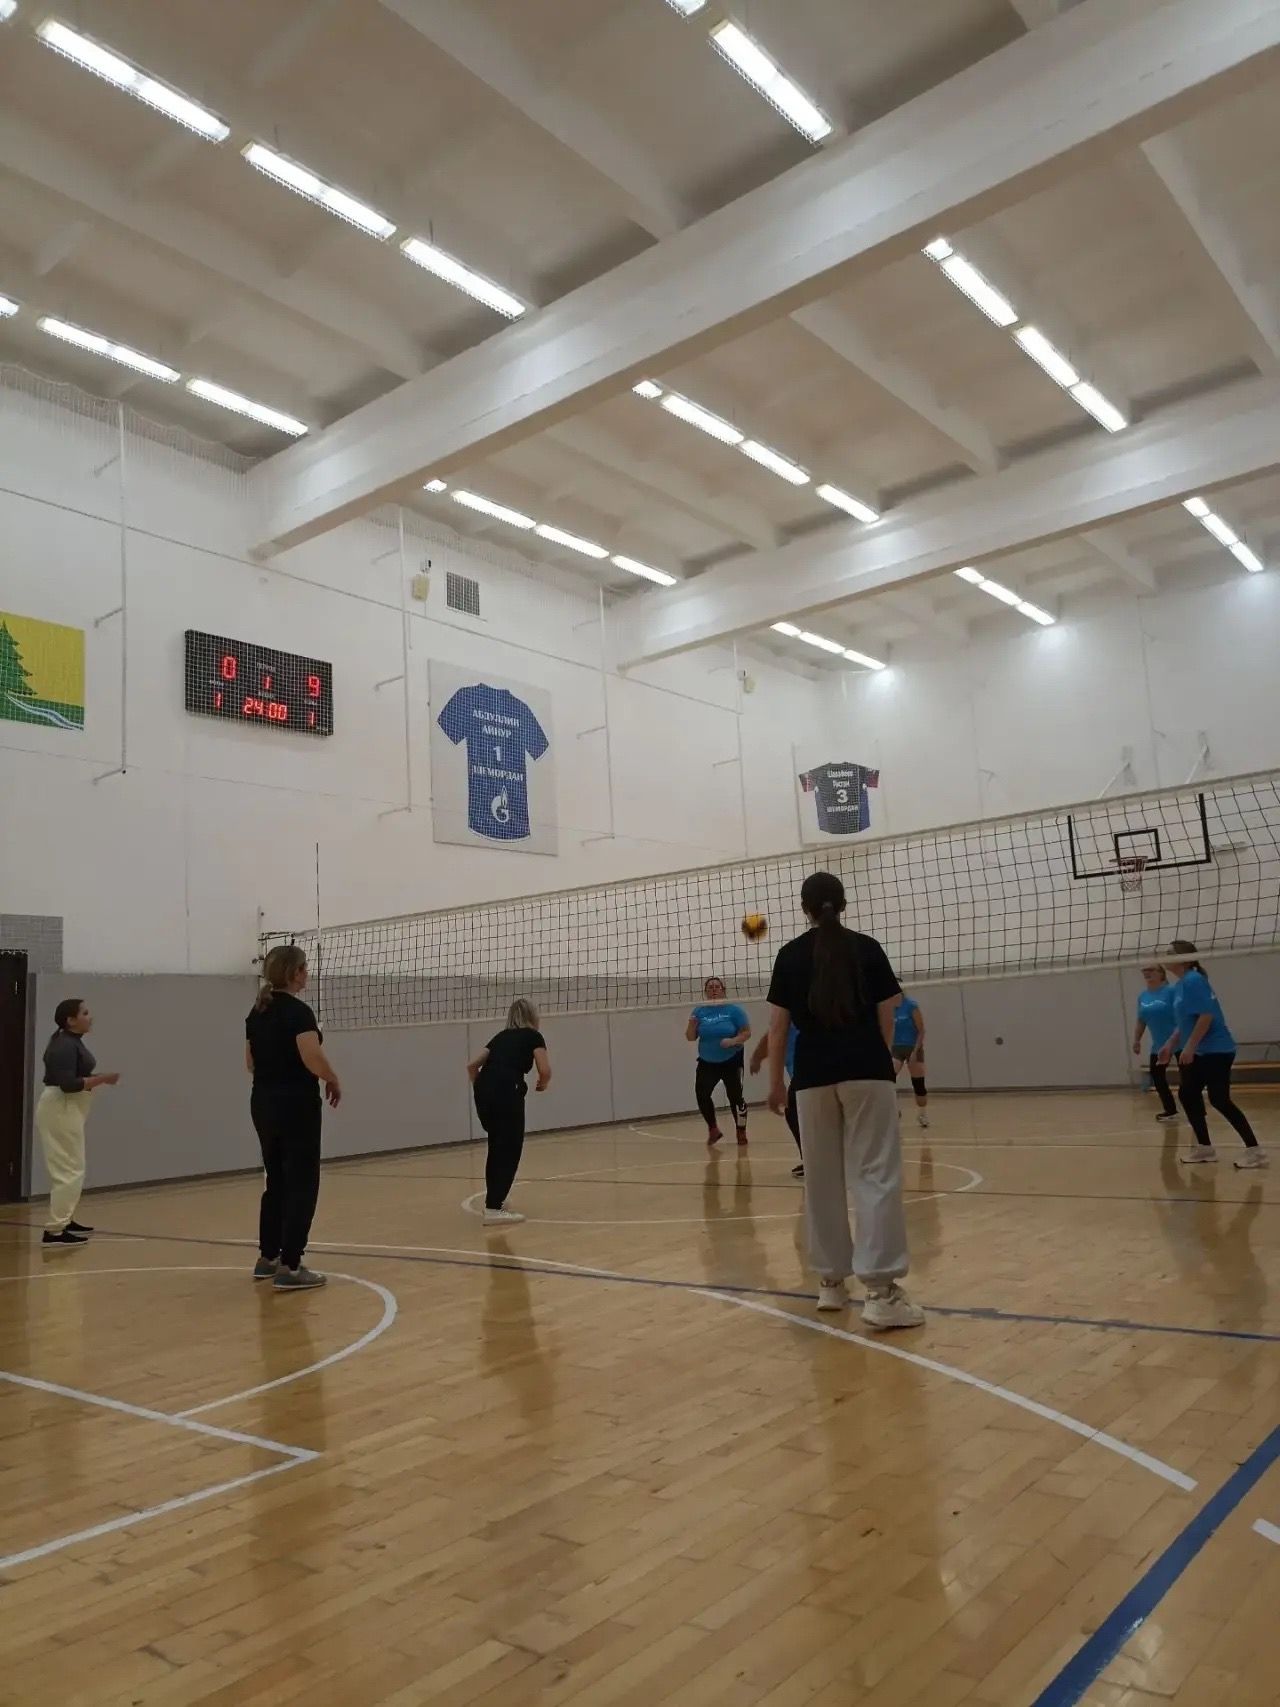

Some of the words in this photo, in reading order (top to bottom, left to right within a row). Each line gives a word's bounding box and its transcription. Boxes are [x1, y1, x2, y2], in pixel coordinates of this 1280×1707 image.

[223, 656, 237, 679] 0
[308, 675, 320, 697] 9
[472, 709, 520, 727] АБДУЛЛИН
[493, 745, 502, 761] 1
[473, 765, 524, 782] ШЕМОРДАН
[836, 788, 849, 804] 3
